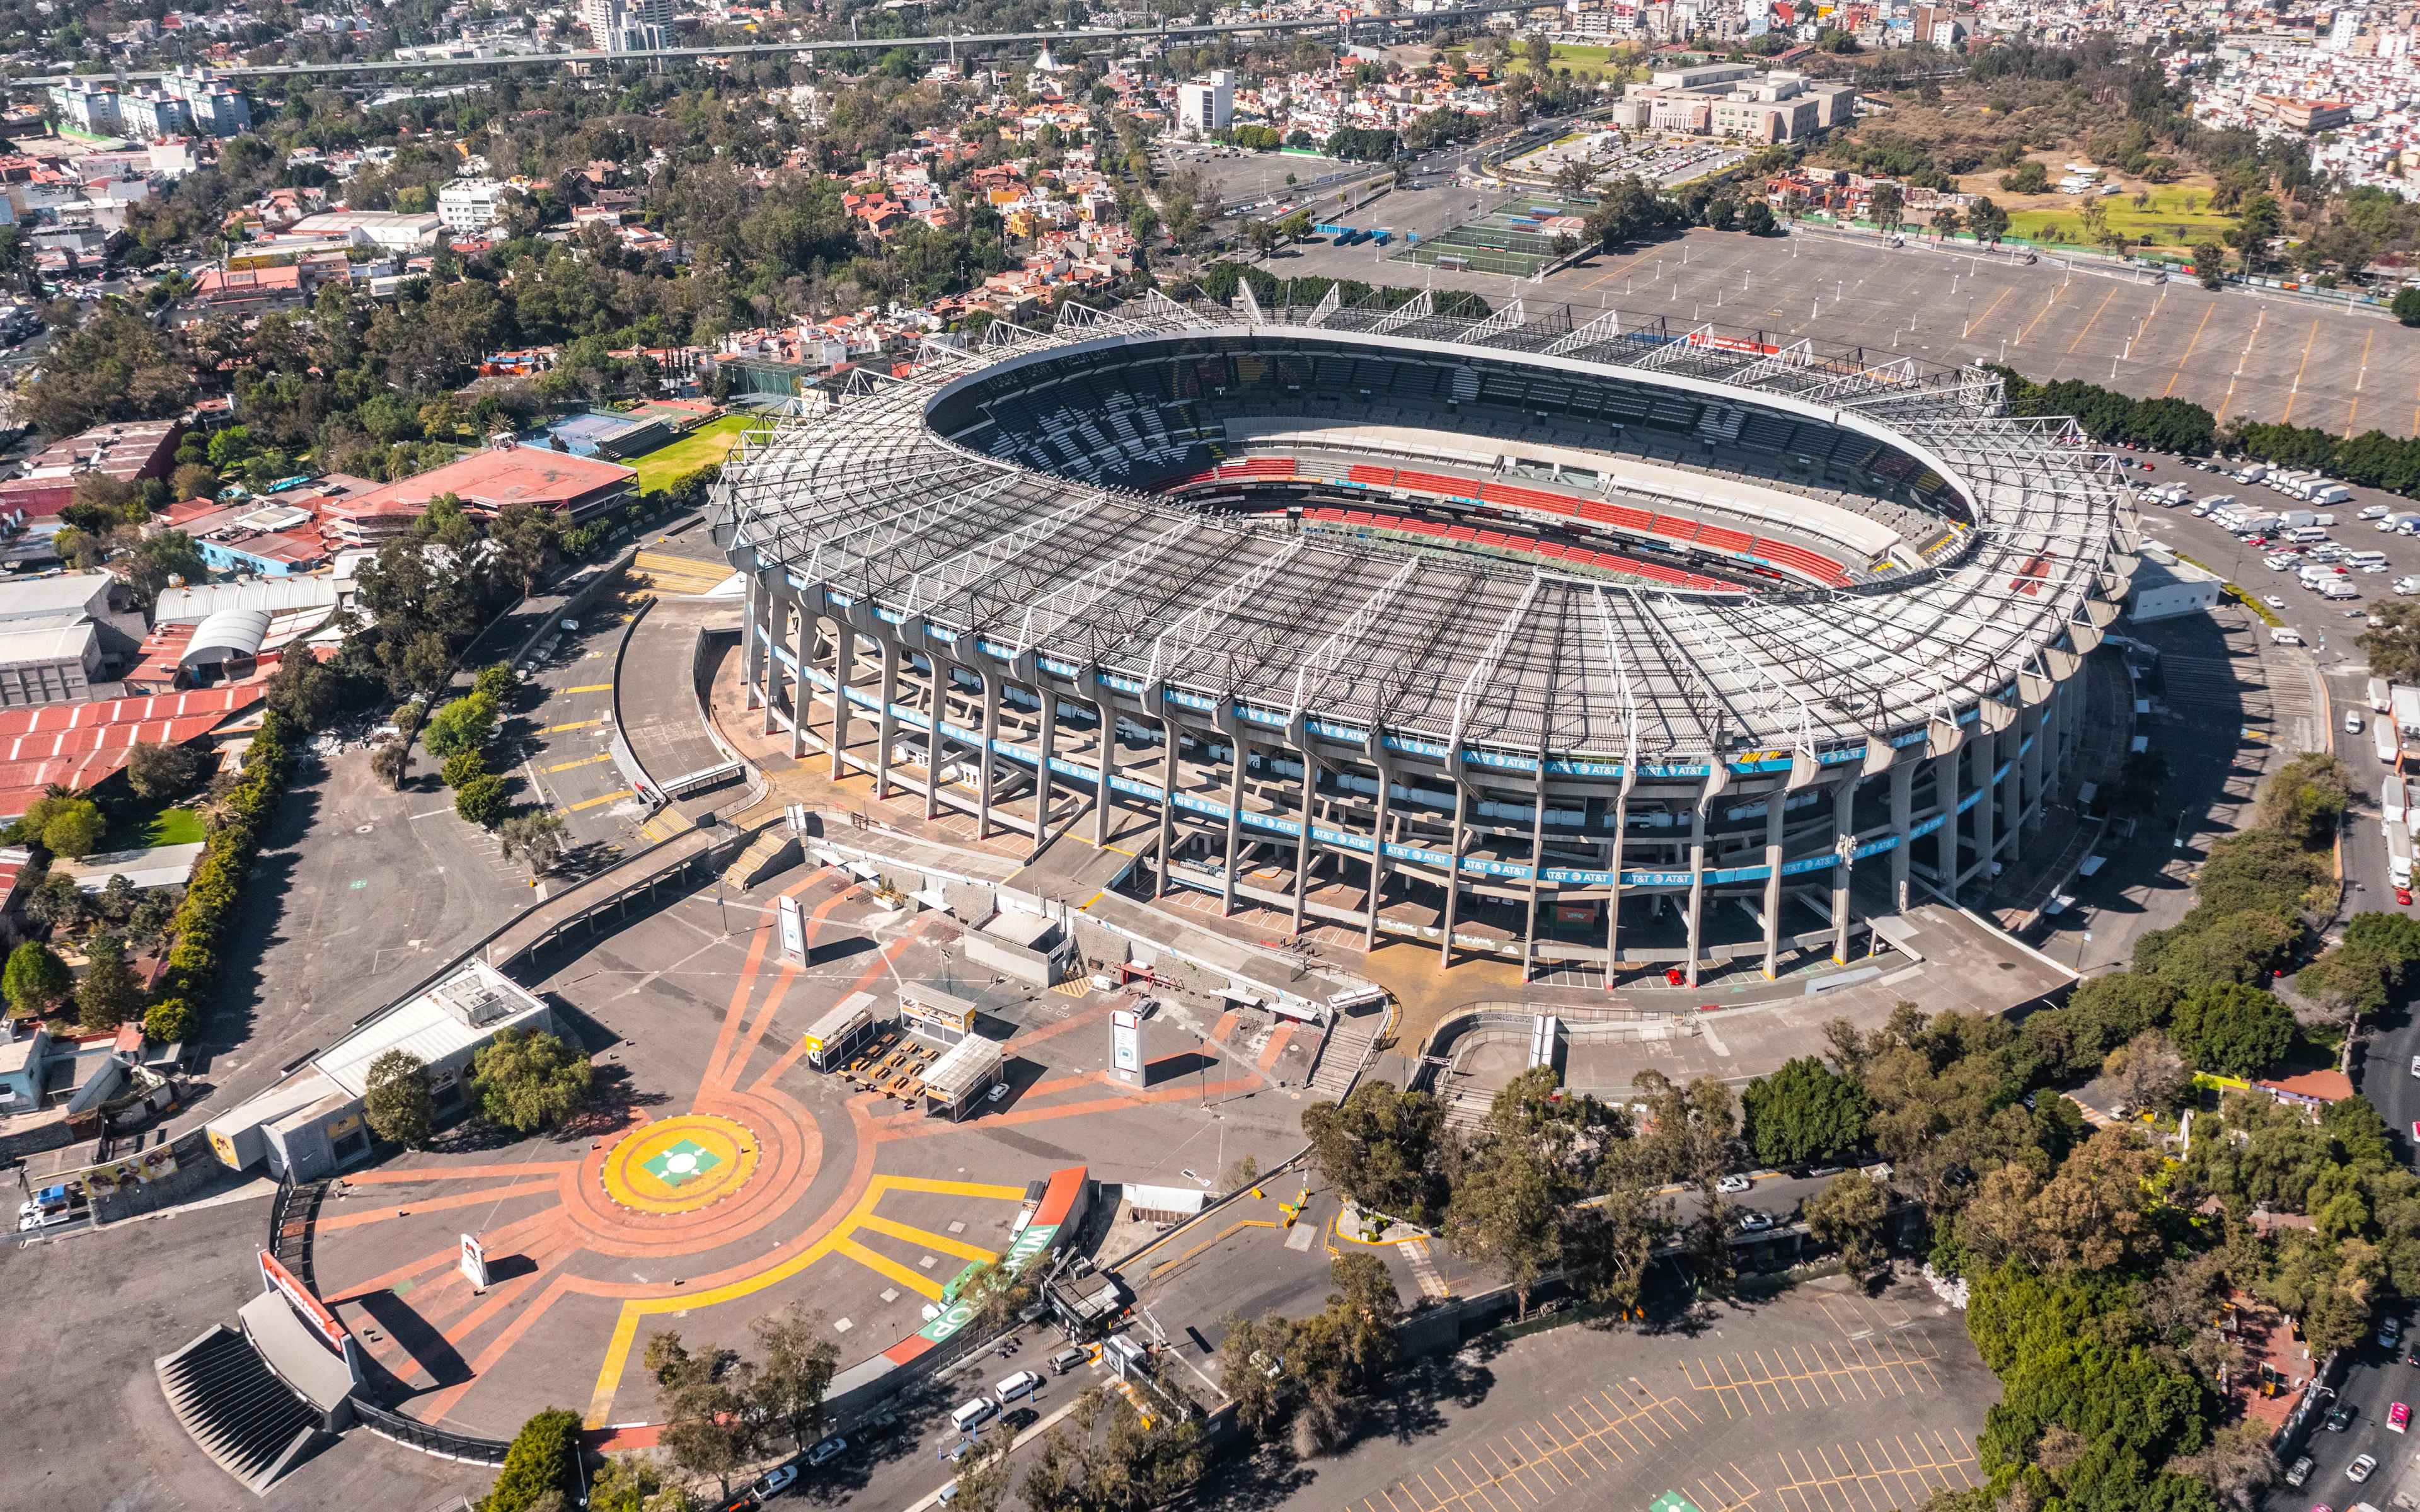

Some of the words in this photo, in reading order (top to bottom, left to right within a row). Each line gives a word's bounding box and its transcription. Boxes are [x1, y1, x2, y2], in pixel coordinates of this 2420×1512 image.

[1103, 674, 1121, 689] AT&T
[1168, 690, 1189, 705] AT&T
[892, 707, 907, 718] AT&T
[1238, 706, 1259, 720] AT&T
[941, 724, 957, 736] AT&T
[1310, 722, 1333, 735] AT&T
[1346, 731, 1370, 743] AT&T
[1387, 736, 1412, 751] AT&T
[994, 743, 1011, 755] AT&T
[1022, 752, 1039, 764] AT&T
[1466, 751, 1492, 765] AT&T
[1507, 759, 1533, 770] AT&T
[1051, 762, 1069, 772] AT&T
[1080, 770, 1098, 781] AT&T
[1550, 762, 1576, 773] AT&T
[1592, 766, 1618, 776] AT&T
[1638, 766, 1664, 776] AT&T
[1678, 766, 1704, 776] AT&T
[1110, 778, 1130, 790] AT&T
[1141, 787, 1161, 799] AT&T
[1174, 795, 1196, 808] AT&T
[1206, 805, 1227, 816] AT&T
[1242, 813, 1264, 825] AT&T
[1276, 822, 1298, 833] AT&T
[1313, 830, 1335, 841] AT&T
[1348, 839, 1371, 849] AT&T
[1877, 837, 1896, 850] AT&T
[1386, 845, 1410, 857] AT&T
[1423, 853, 1447, 864] AT&T
[1464, 860, 1488, 871] AT&T
[1502, 866, 1528, 876] AT&T
[1781, 862, 1802, 874] AT&T
[1814, 856, 1835, 868] AT&T
[1545, 871, 1569, 881] AT&T
[1583, 873, 1609, 883] AT&T
[1626, 874, 1651, 883] AT&T
[1665, 874, 1690, 883] AT&T
[926, 1015, 942, 1024] Corona
